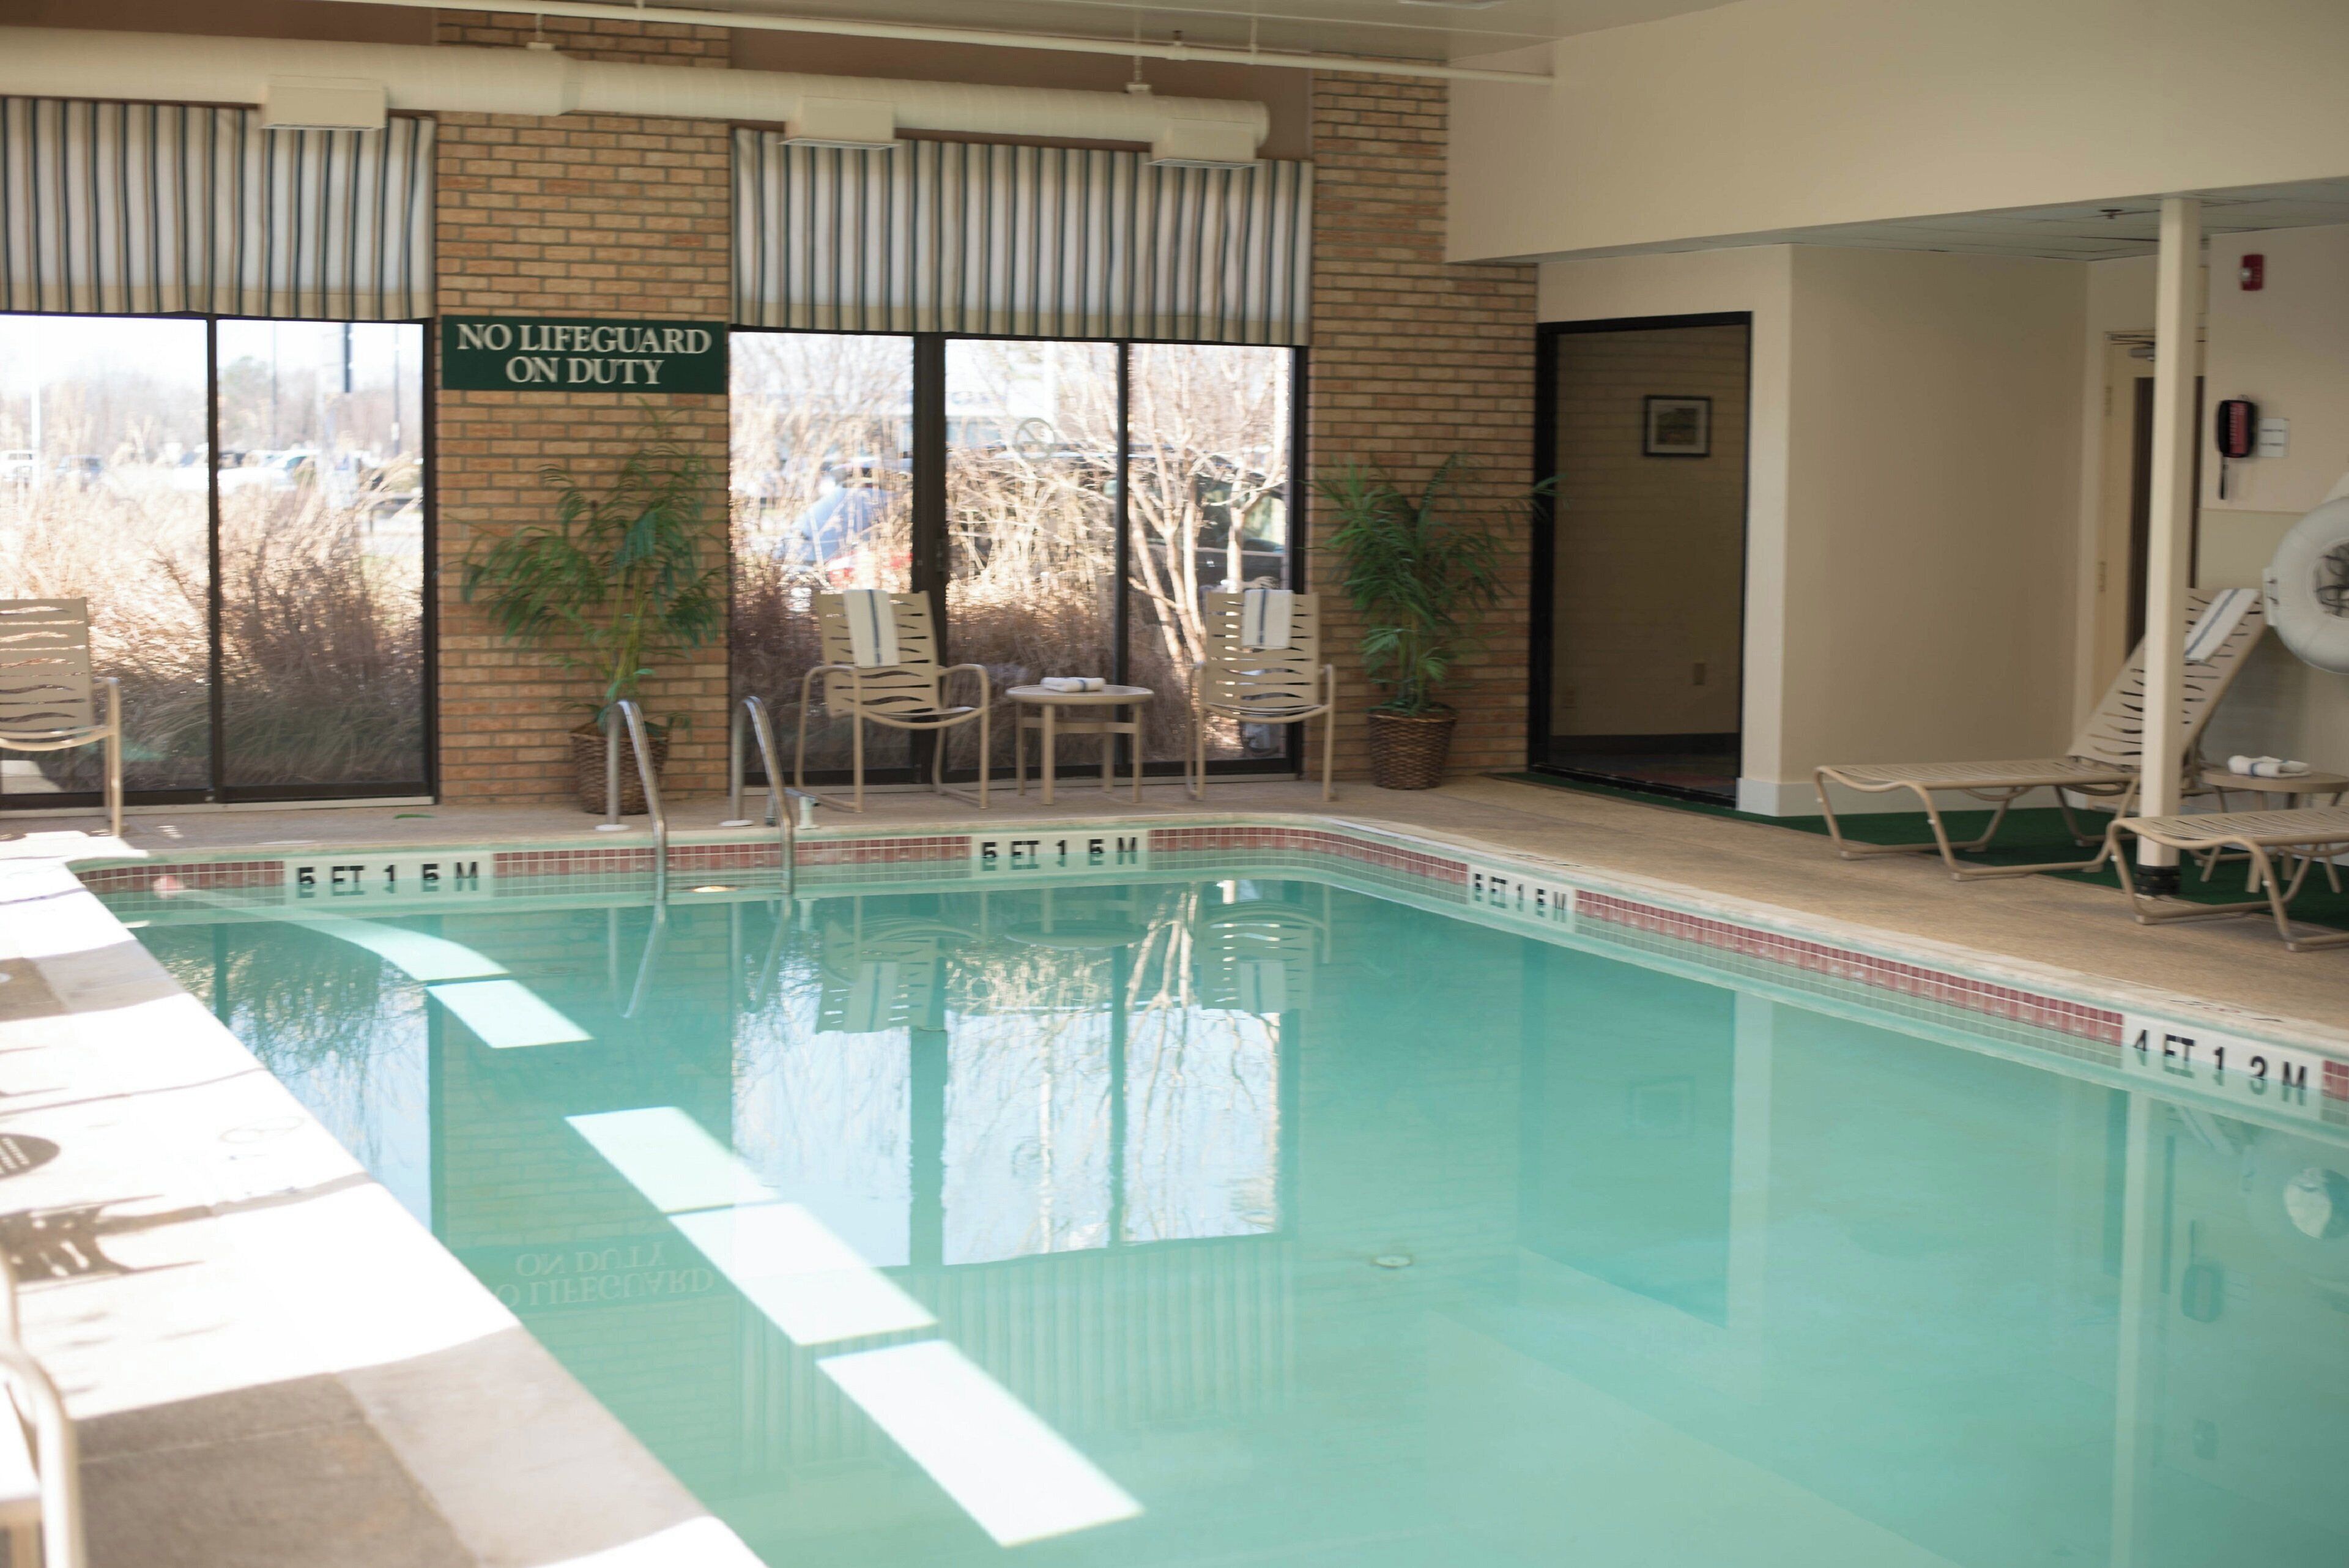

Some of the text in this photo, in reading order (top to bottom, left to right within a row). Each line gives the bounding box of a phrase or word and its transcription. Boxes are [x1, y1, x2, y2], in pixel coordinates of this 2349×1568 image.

[457, 324, 713, 354] NO LIFEGUARD
[505, 356, 666, 385] ON DUTY
